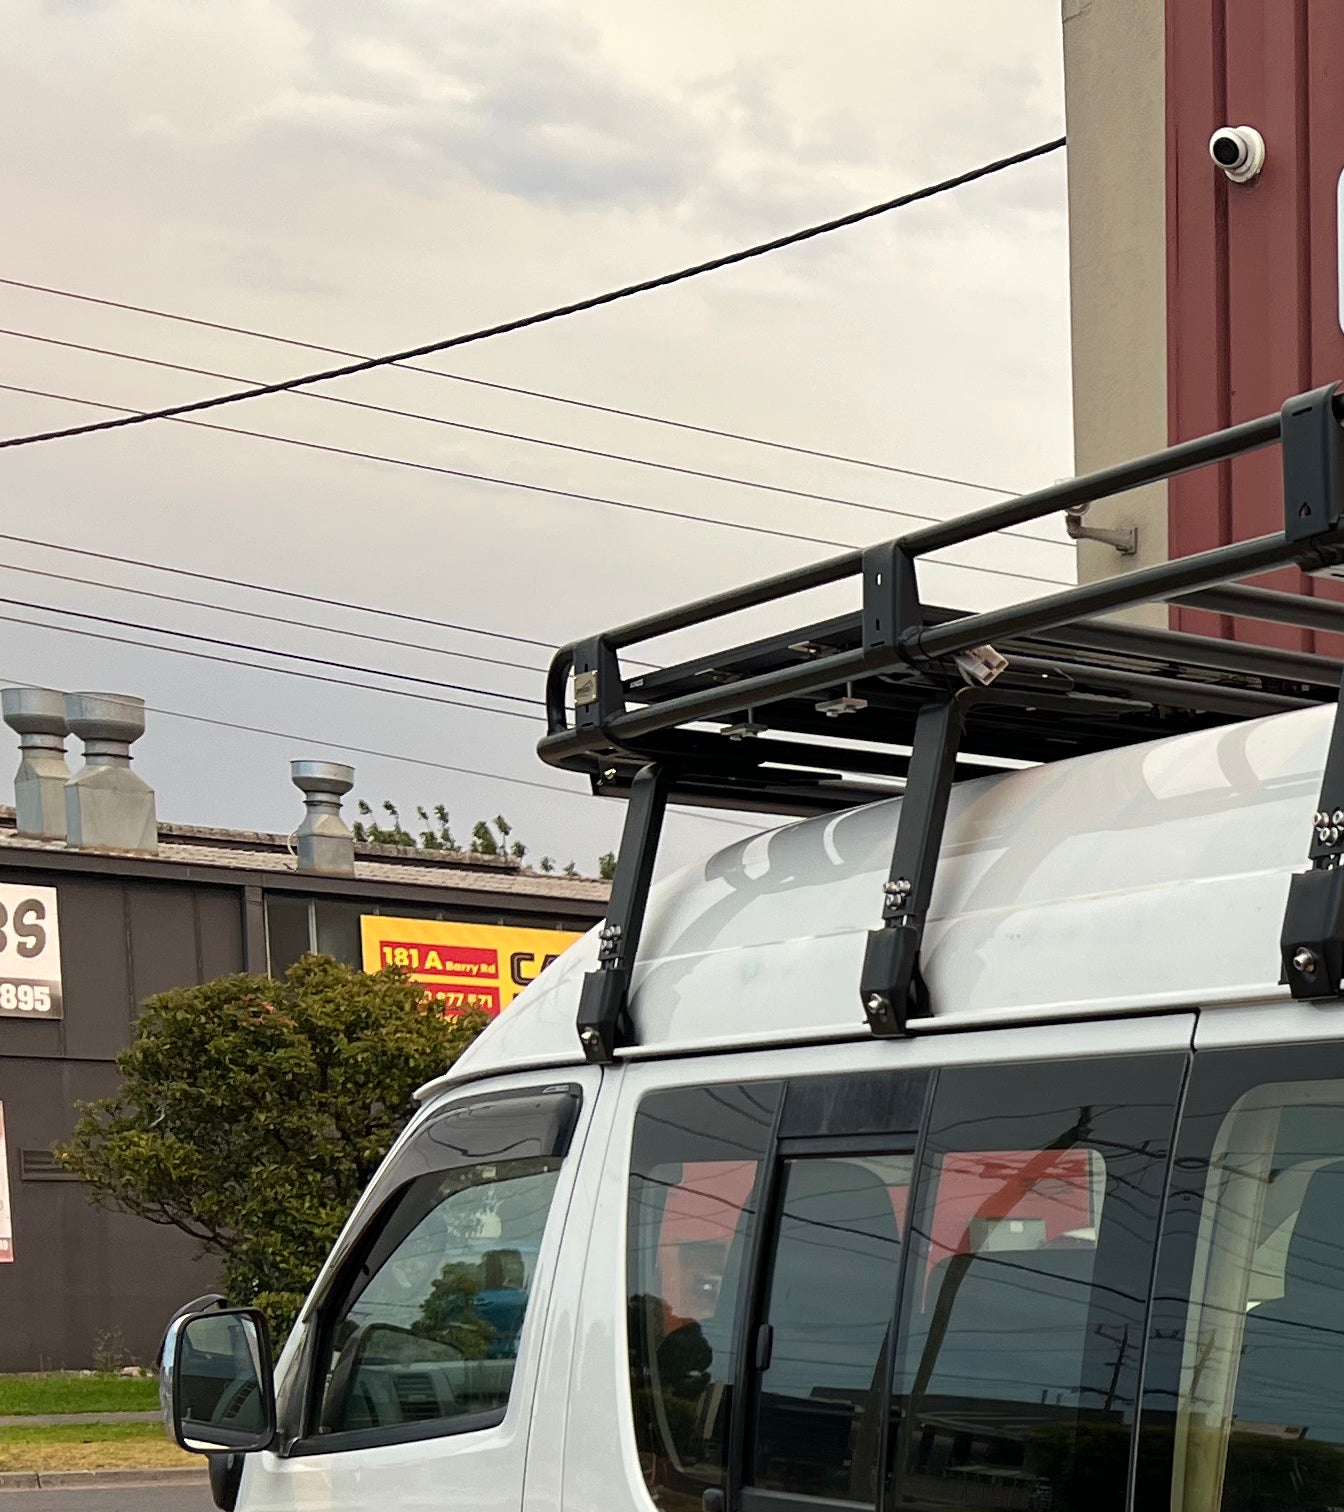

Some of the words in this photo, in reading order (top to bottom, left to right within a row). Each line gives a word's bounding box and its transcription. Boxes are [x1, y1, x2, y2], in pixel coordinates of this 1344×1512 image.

[0, 898, 46, 958] S
[383, 946, 419, 969] 181
[424, 950, 443, 970] A
[445, 961, 479, 975] Barry
[480, 963, 496, 974] Rd
